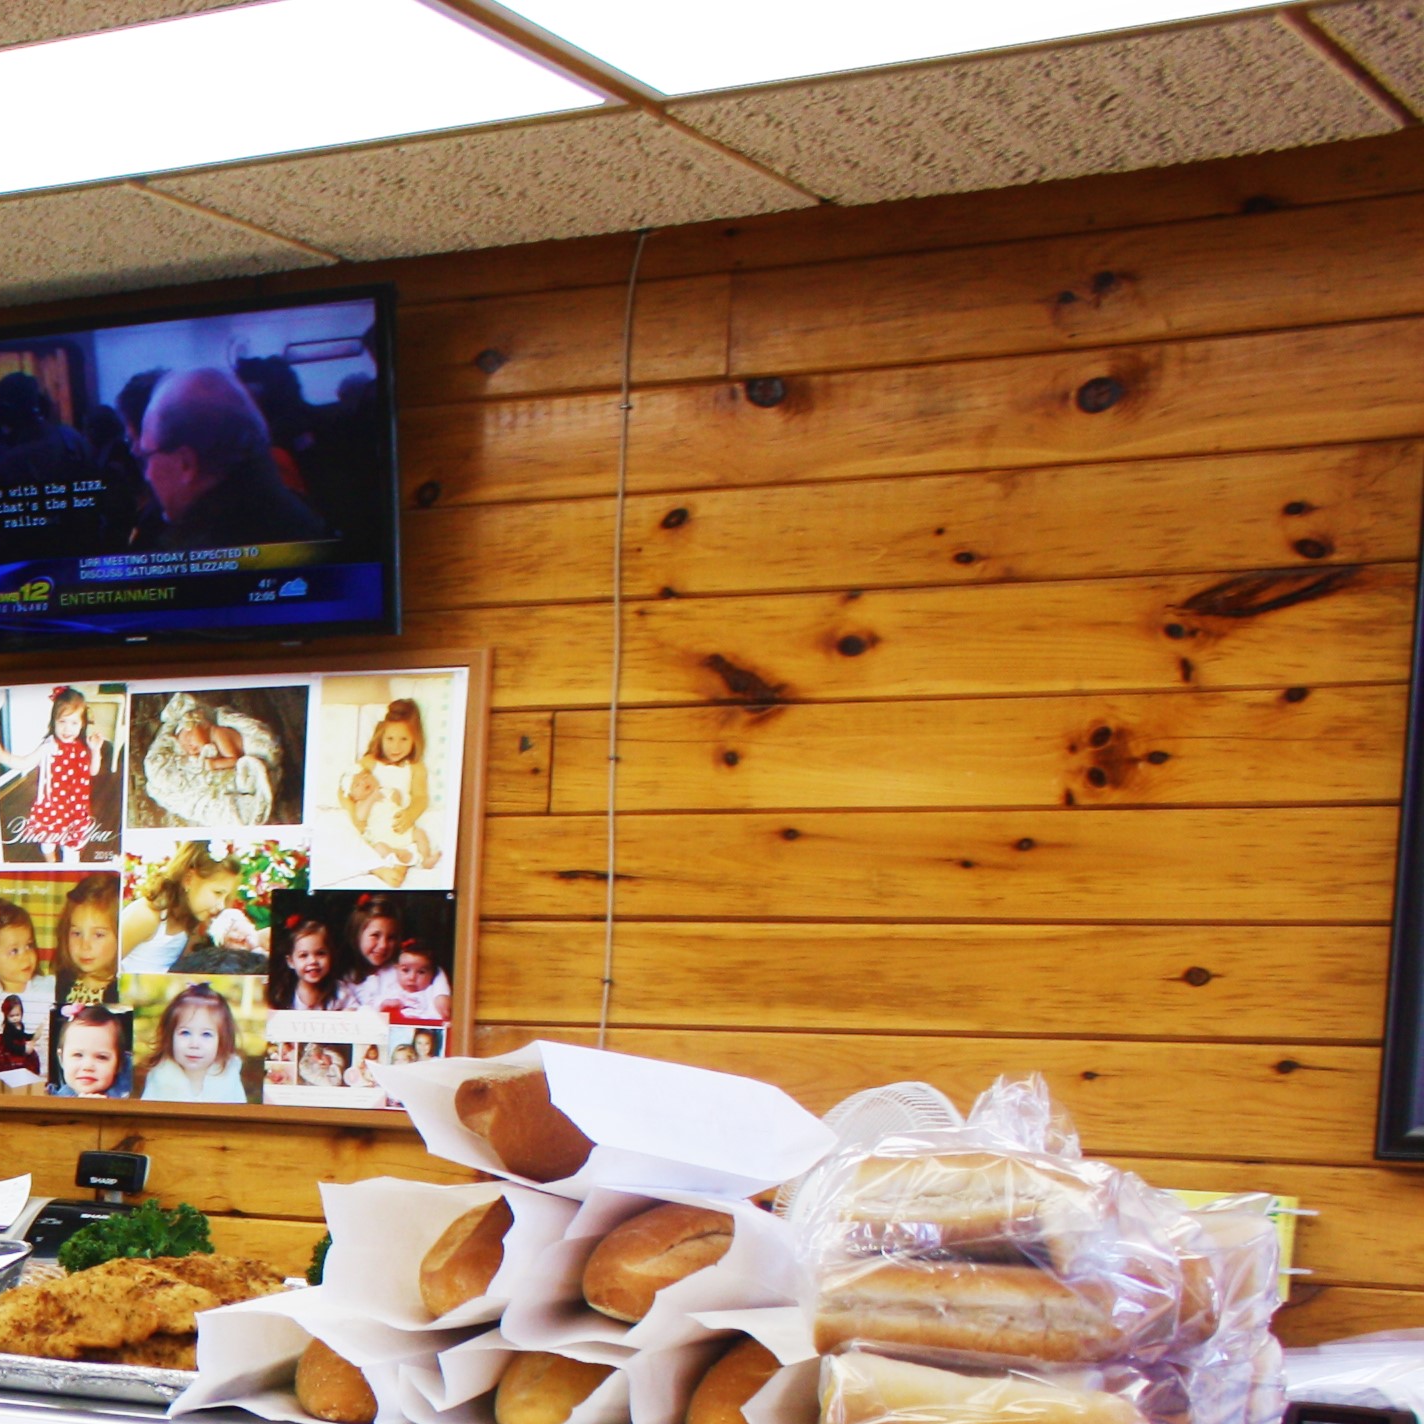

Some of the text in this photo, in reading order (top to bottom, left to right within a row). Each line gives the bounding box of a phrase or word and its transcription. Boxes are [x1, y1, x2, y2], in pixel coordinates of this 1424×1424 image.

[9, 485, 38, 497] with
[44, 483, 67, 495] the
[45, 499, 67, 510] the
[72, 496, 96, 508] hot
[4, 515, 47, 528] railro
[102, 553, 148, 566] MEETING
[189, 547, 242, 561] EXPECTED
[244, 546, 259, 558] TO
[80, 559, 238, 580] DISCUSS SATURDAY'S BLIZZARD
[20, 580, 50, 601] 12
[60, 586, 176, 606] ENTERTAINMENT
[89, 1176, 118, 1186] SHARP
